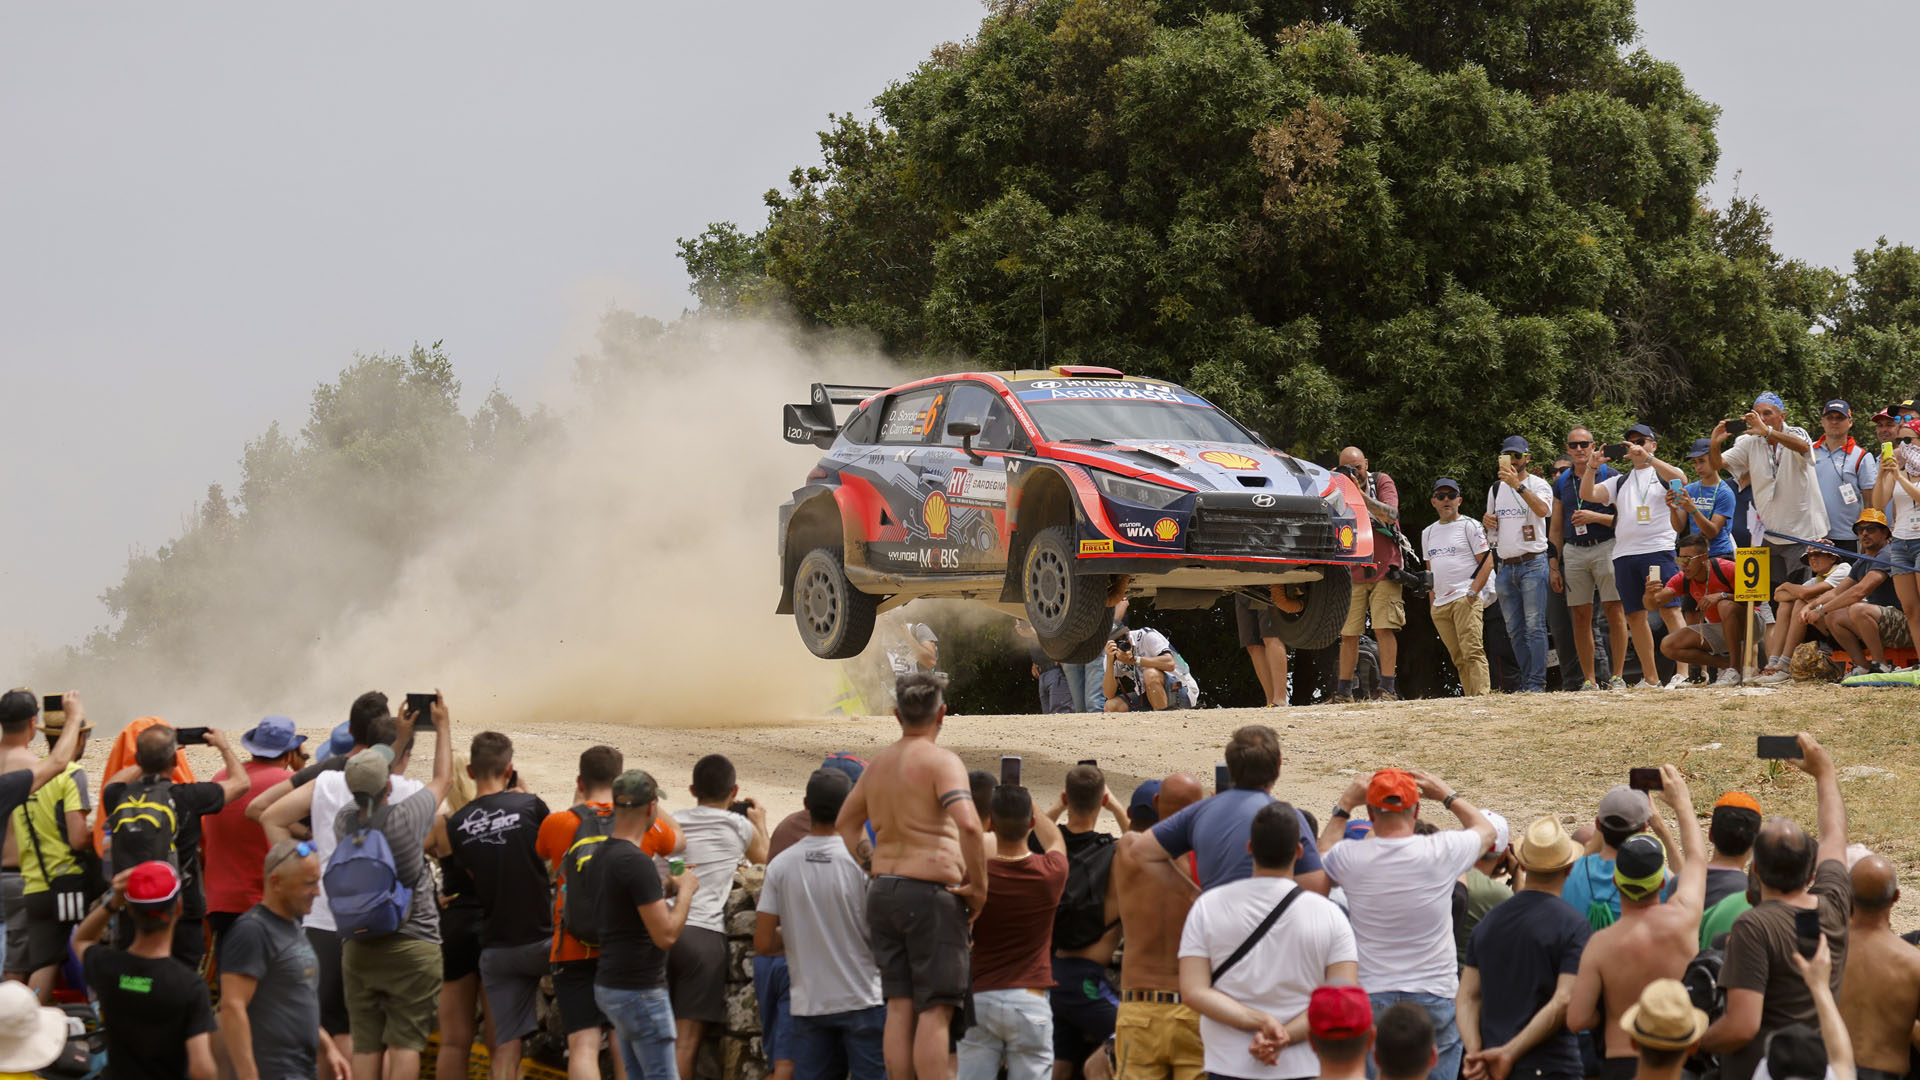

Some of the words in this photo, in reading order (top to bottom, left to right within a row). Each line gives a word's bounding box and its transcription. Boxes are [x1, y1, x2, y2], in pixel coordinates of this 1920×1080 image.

[1065, 379, 1139, 389] HYUNDAI
[889, 410, 898, 421] D.
[898, 410, 918, 421] Sordo
[923, 393, 944, 436] 6
[787, 426, 803, 439] i20
[881, 423, 889, 435] C.
[890, 423, 914, 435] Carrera
[1006, 460, 1021, 473] N
[948, 470, 967, 494] HY
[972, 479, 1006, 491] SARDEGNA
[1082, 541, 1111, 552] PIRELLI
[888, 551, 918, 562] HYUNDAI
[919, 547, 960, 569] MOBIS
[1743, 556, 1760, 589] 9
